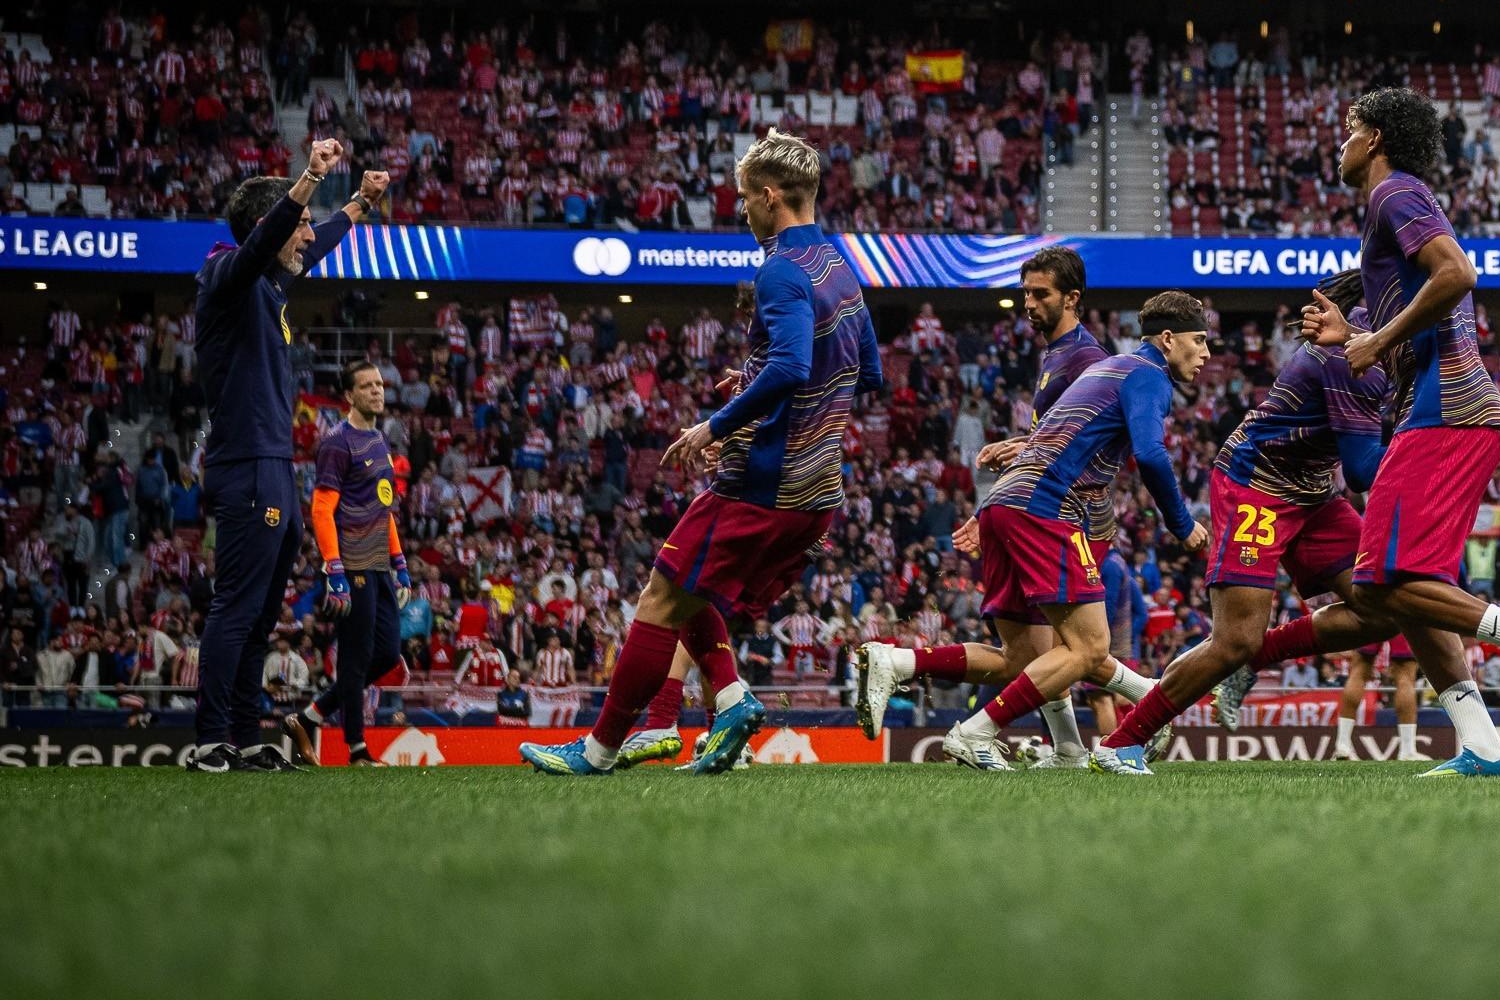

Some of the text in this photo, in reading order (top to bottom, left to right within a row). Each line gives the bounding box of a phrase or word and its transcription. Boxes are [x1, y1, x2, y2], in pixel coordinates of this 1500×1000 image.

[14, 229, 138, 259] LEAGUE
[638, 246, 765, 269] mastercard
[1192, 248, 1270, 275] UEFA
[1233, 504, 1276, 545] 23
